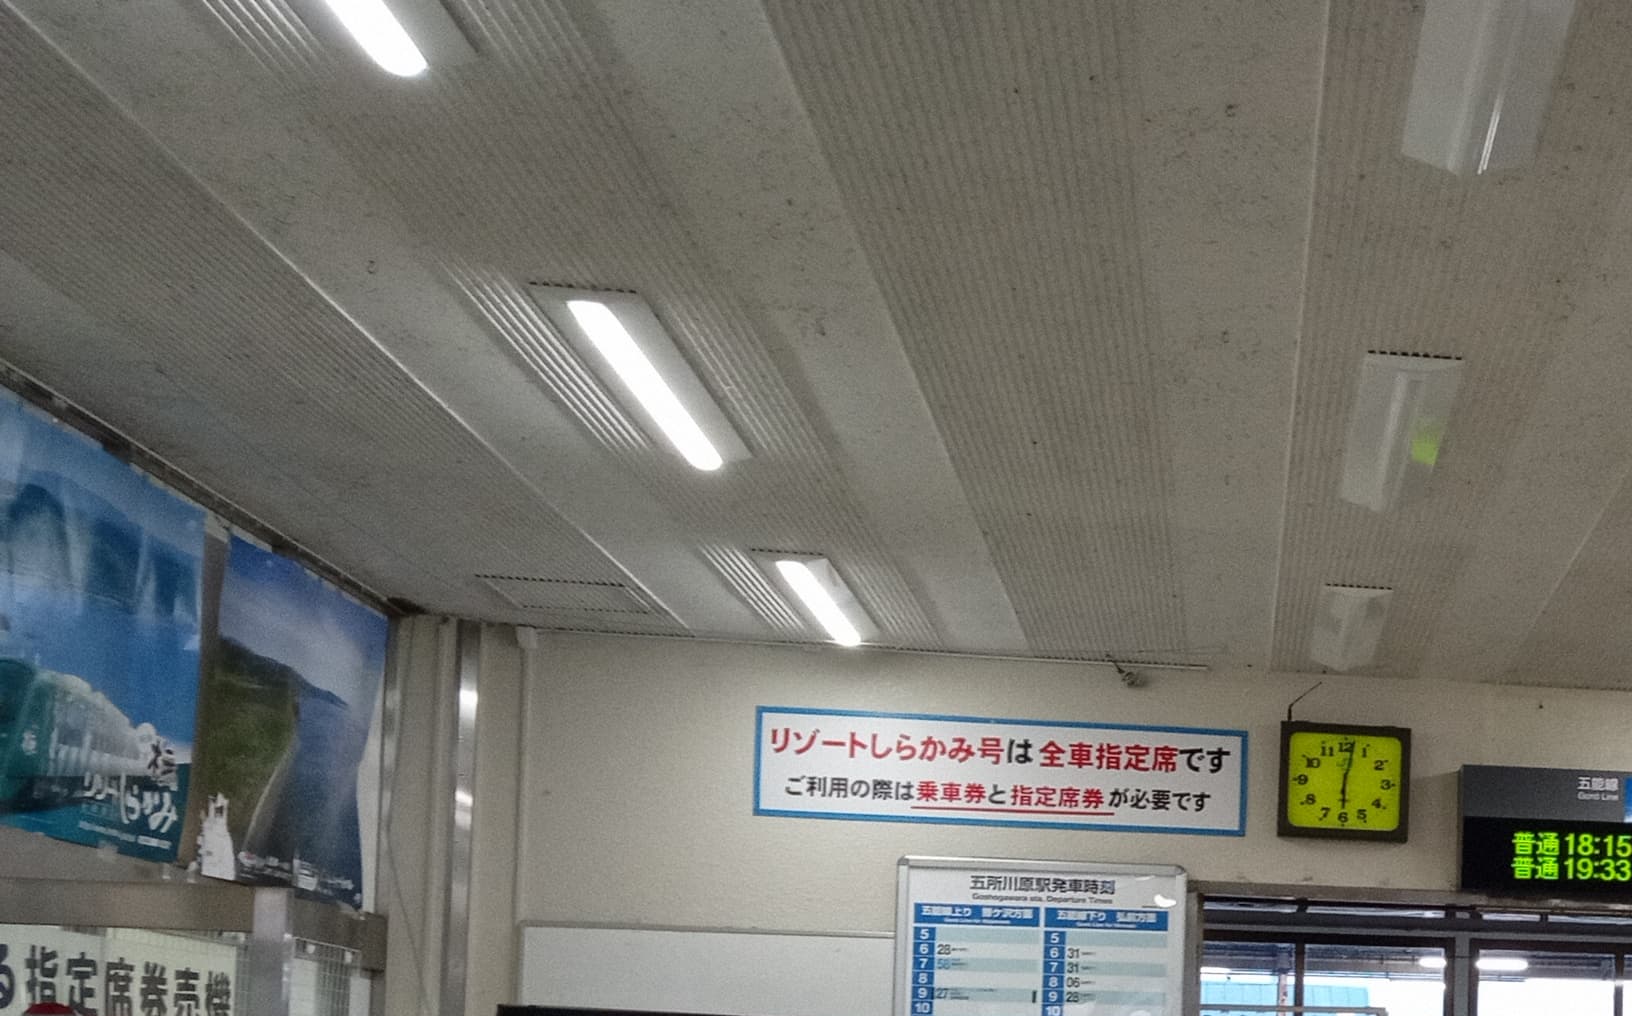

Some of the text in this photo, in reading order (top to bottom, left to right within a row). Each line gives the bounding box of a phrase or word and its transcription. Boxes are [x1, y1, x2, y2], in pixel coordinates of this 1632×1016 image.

[1374, 760, 1384, 771] 2
[1297, 774, 1308, 785] 9
[1380, 779, 1391, 790] 3
[1305, 794, 1316, 805] 8
[1371, 799, 1381, 809] 4
[1320, 808, 1331, 818] 7
[1338, 812, 1348, 823] 6
[1357, 809, 1367, 821] 5
[1512, 833, 1560, 856] 普通
[1564, 834, 1632, 857] 18:15
[1511, 857, 1559, 880] 普通
[1564, 858, 1632, 881] 19:33
[920, 929, 929, 939] 5
[1051, 934, 1059, 943] 5
[920, 944, 928, 954] 6
[1050, 948, 1059, 958] 6
[920, 959, 928, 969] 7
[1050, 963, 1058, 972] 7
[919, 974, 928, 983] 8
[1049, 978, 1058, 987] 8
[918, 988, 927, 998] 9
[1049, 992, 1057, 1002] 9
[915, 1003, 930, 1013] 10
[1046, 1007, 1060, 1016] 10
